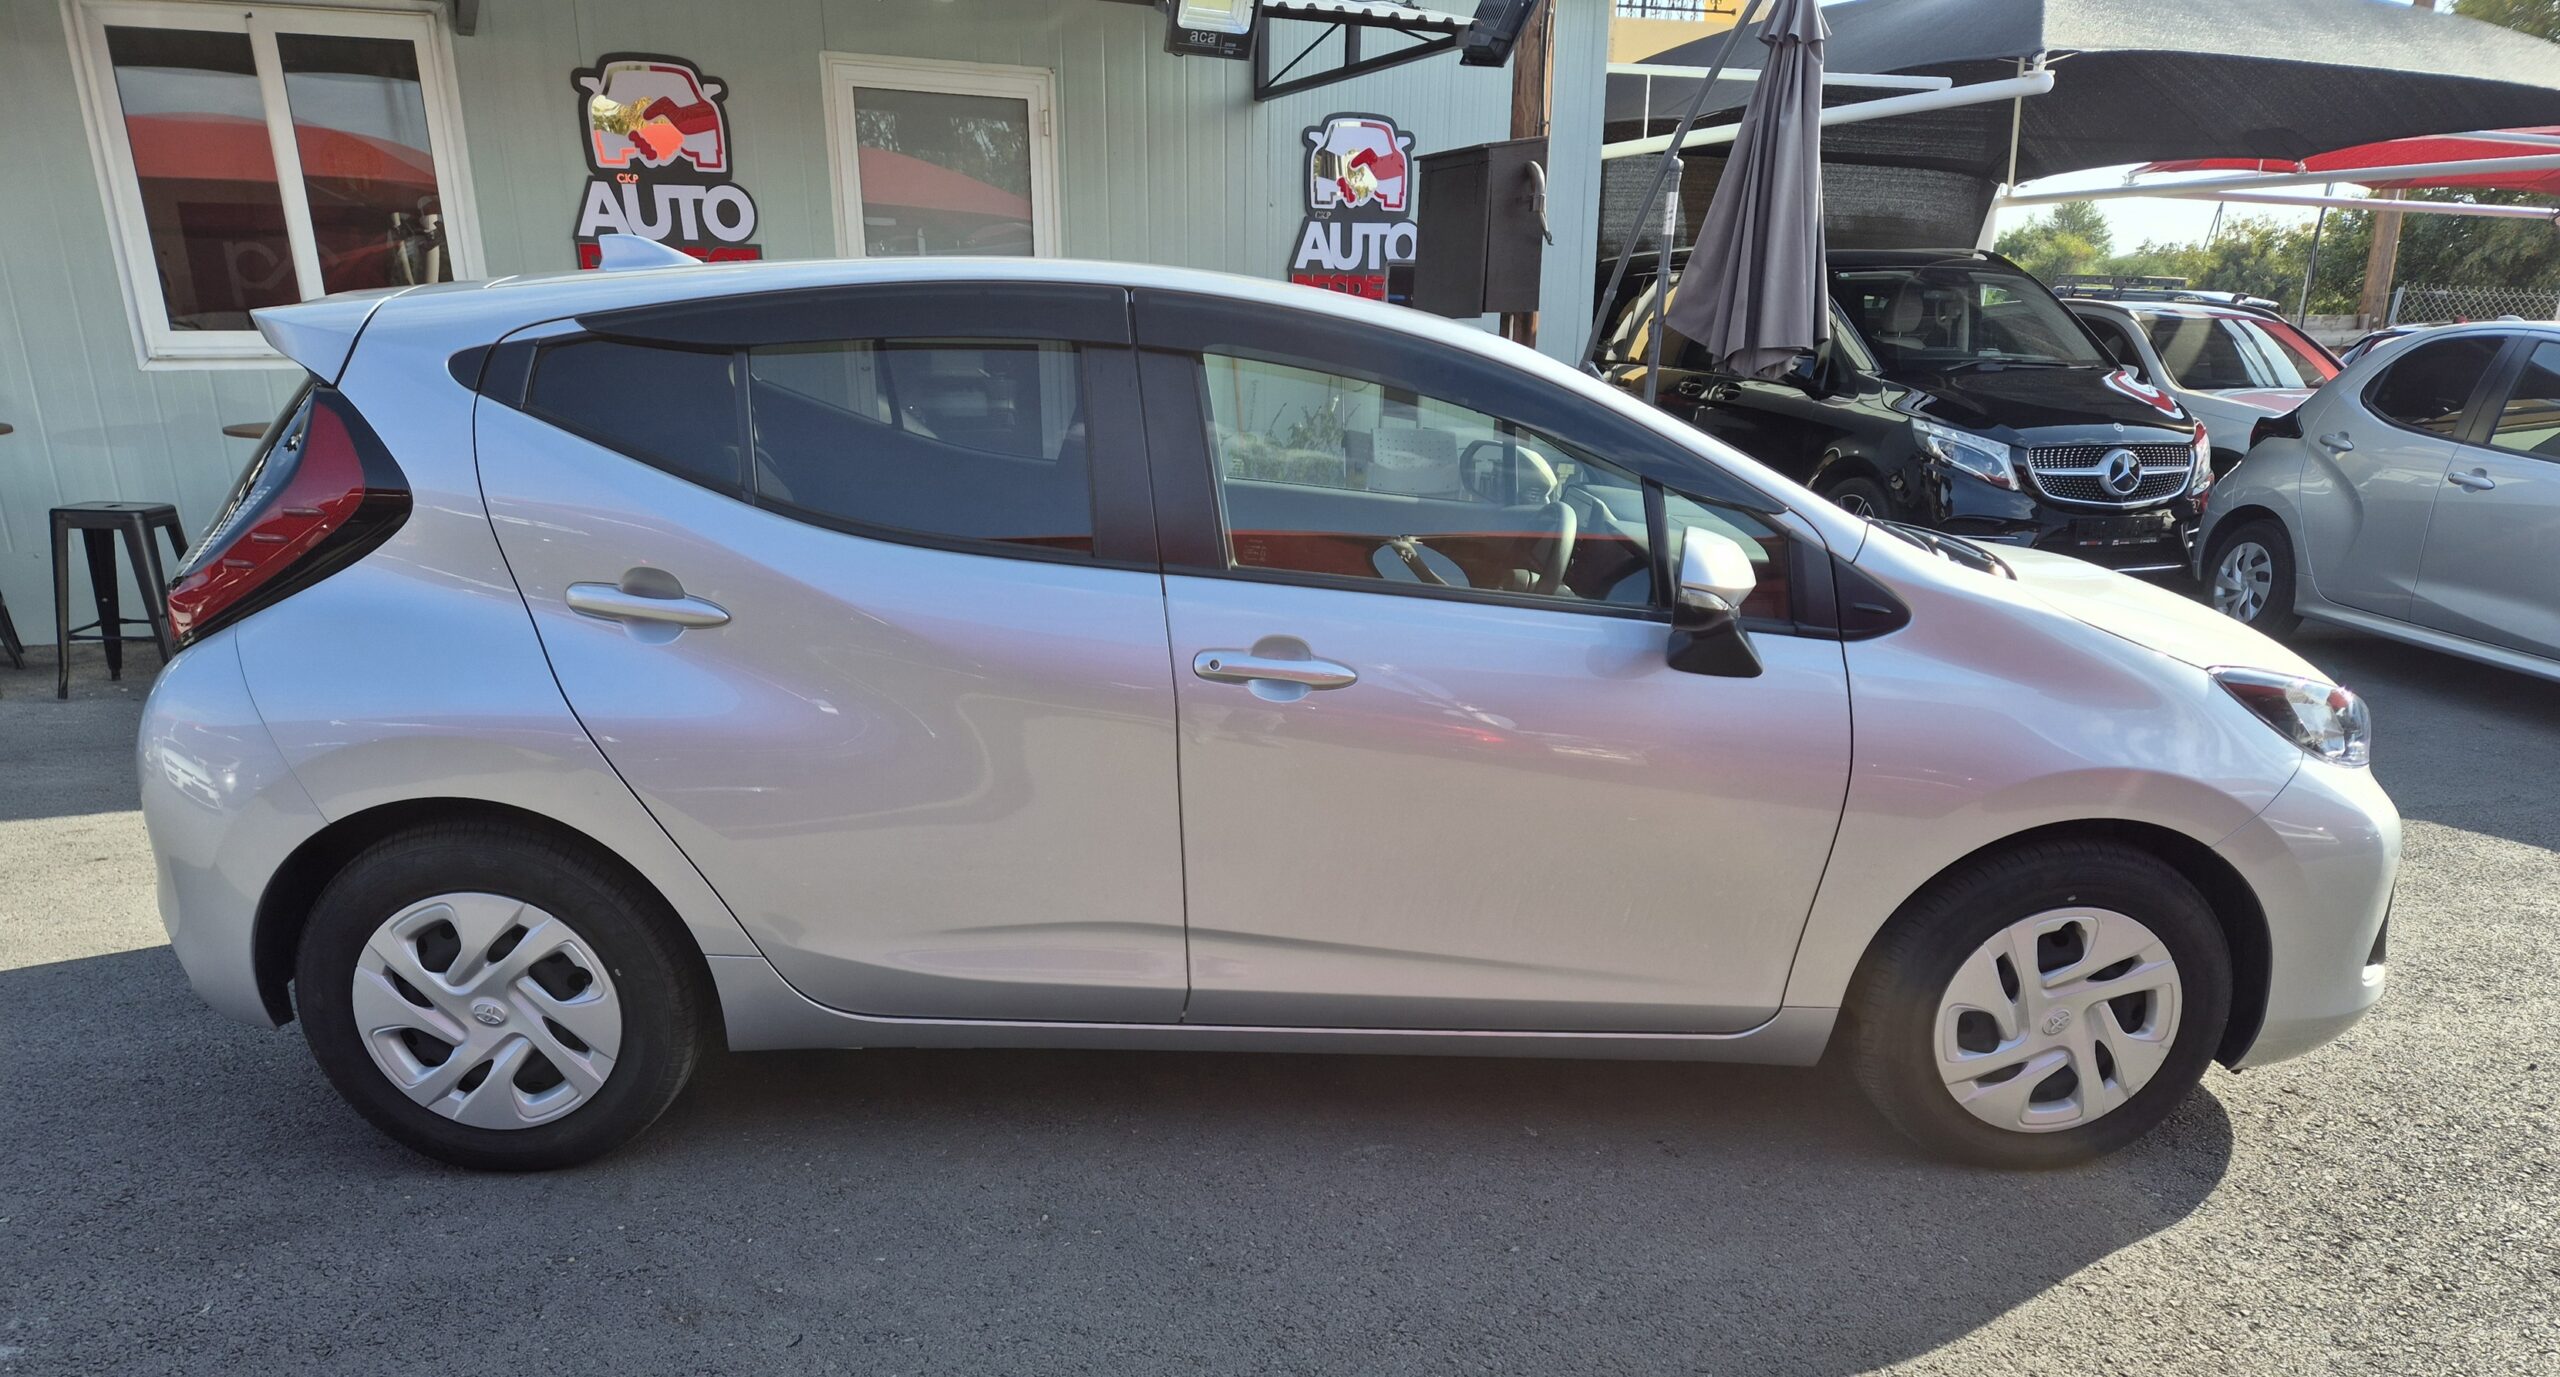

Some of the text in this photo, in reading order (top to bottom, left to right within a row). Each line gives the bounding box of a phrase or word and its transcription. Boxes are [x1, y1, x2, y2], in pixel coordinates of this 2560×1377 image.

[1190, 31, 1217, 43] aca
[578, 181, 755, 242] AUTO
[1294, 221, 1417, 270] AUTO
